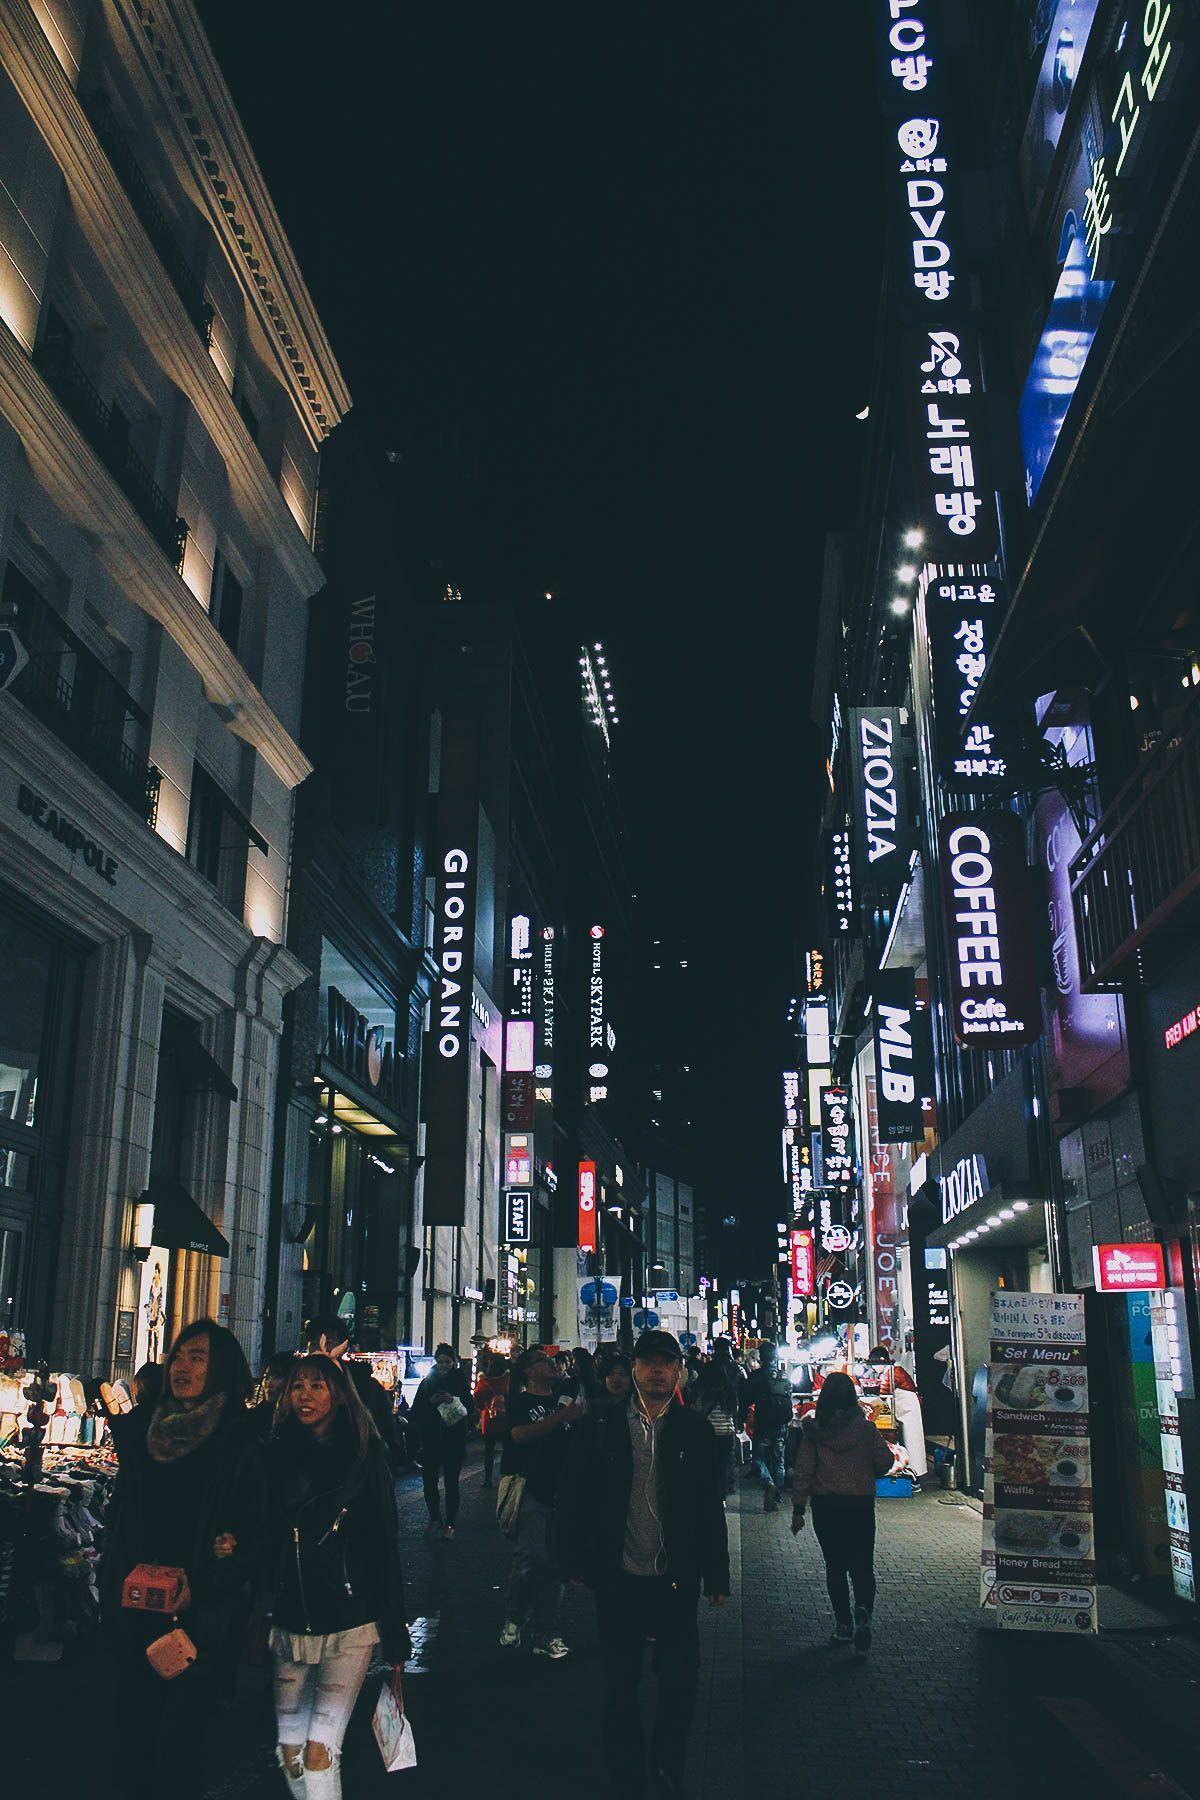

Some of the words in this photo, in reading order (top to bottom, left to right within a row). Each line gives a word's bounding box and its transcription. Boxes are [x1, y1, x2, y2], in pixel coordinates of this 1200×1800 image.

[889, 0, 932, 90] PC방
[907, 181, 955, 300] DVD방
[926, 404, 982, 536] 노래방
[861, 717, 897, 863] ZIOZIA
[17, 784, 118, 886] BEANPOLE
[949, 826, 1002, 987] COFFEE
[439, 849, 468, 1058] GIORDANO
[593, 943, 601, 974] HOTEL
[590, 976, 603, 1048] SKYPARK
[961, 998, 1006, 1019] Cafe
[878, 1004, 916, 1104] MLB
[512, 1198, 524, 1237] STAFF
[941, 1154, 983, 1225] ZIOZIA
[876, 1234, 896, 1291] JOE
[993, 1328, 1005, 1337] The
[1004, 1347, 1027, 1359] Set
[1032, 1348, 1071, 1361] Menu
[997, 1411, 1045, 1421] Sandwich
[1050, 1423, 1087, 1431] Americano
[1003, 1485, 1034, 1495] Waffle
[999, 1557, 1028, 1569] Honey
[1032, 1558, 1060, 1569] Bread
